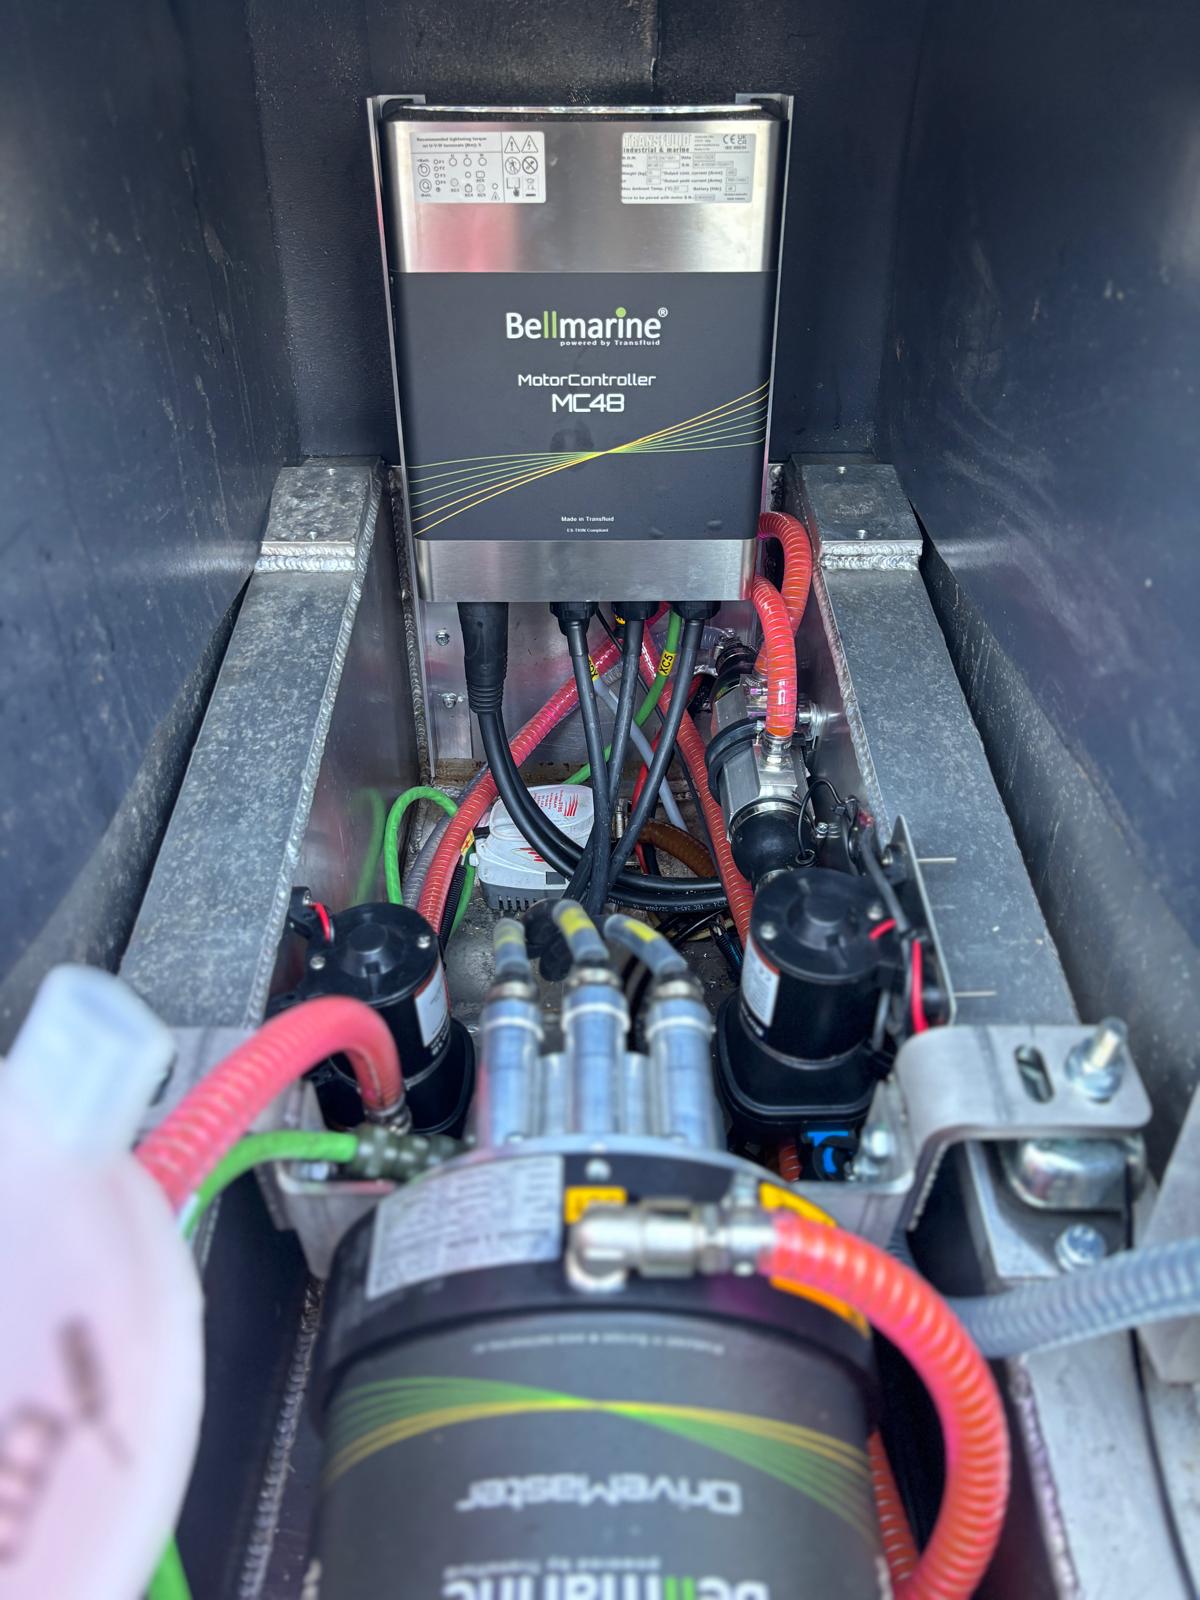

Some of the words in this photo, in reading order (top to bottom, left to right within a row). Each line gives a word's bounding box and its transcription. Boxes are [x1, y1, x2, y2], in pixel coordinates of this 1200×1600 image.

[518, 373, 656, 387] MotorController
[552, 393, 625, 413] MC48
[659, 654, 673, 675] XC5
[456, 1474, 742, 1515] DriveMaster
